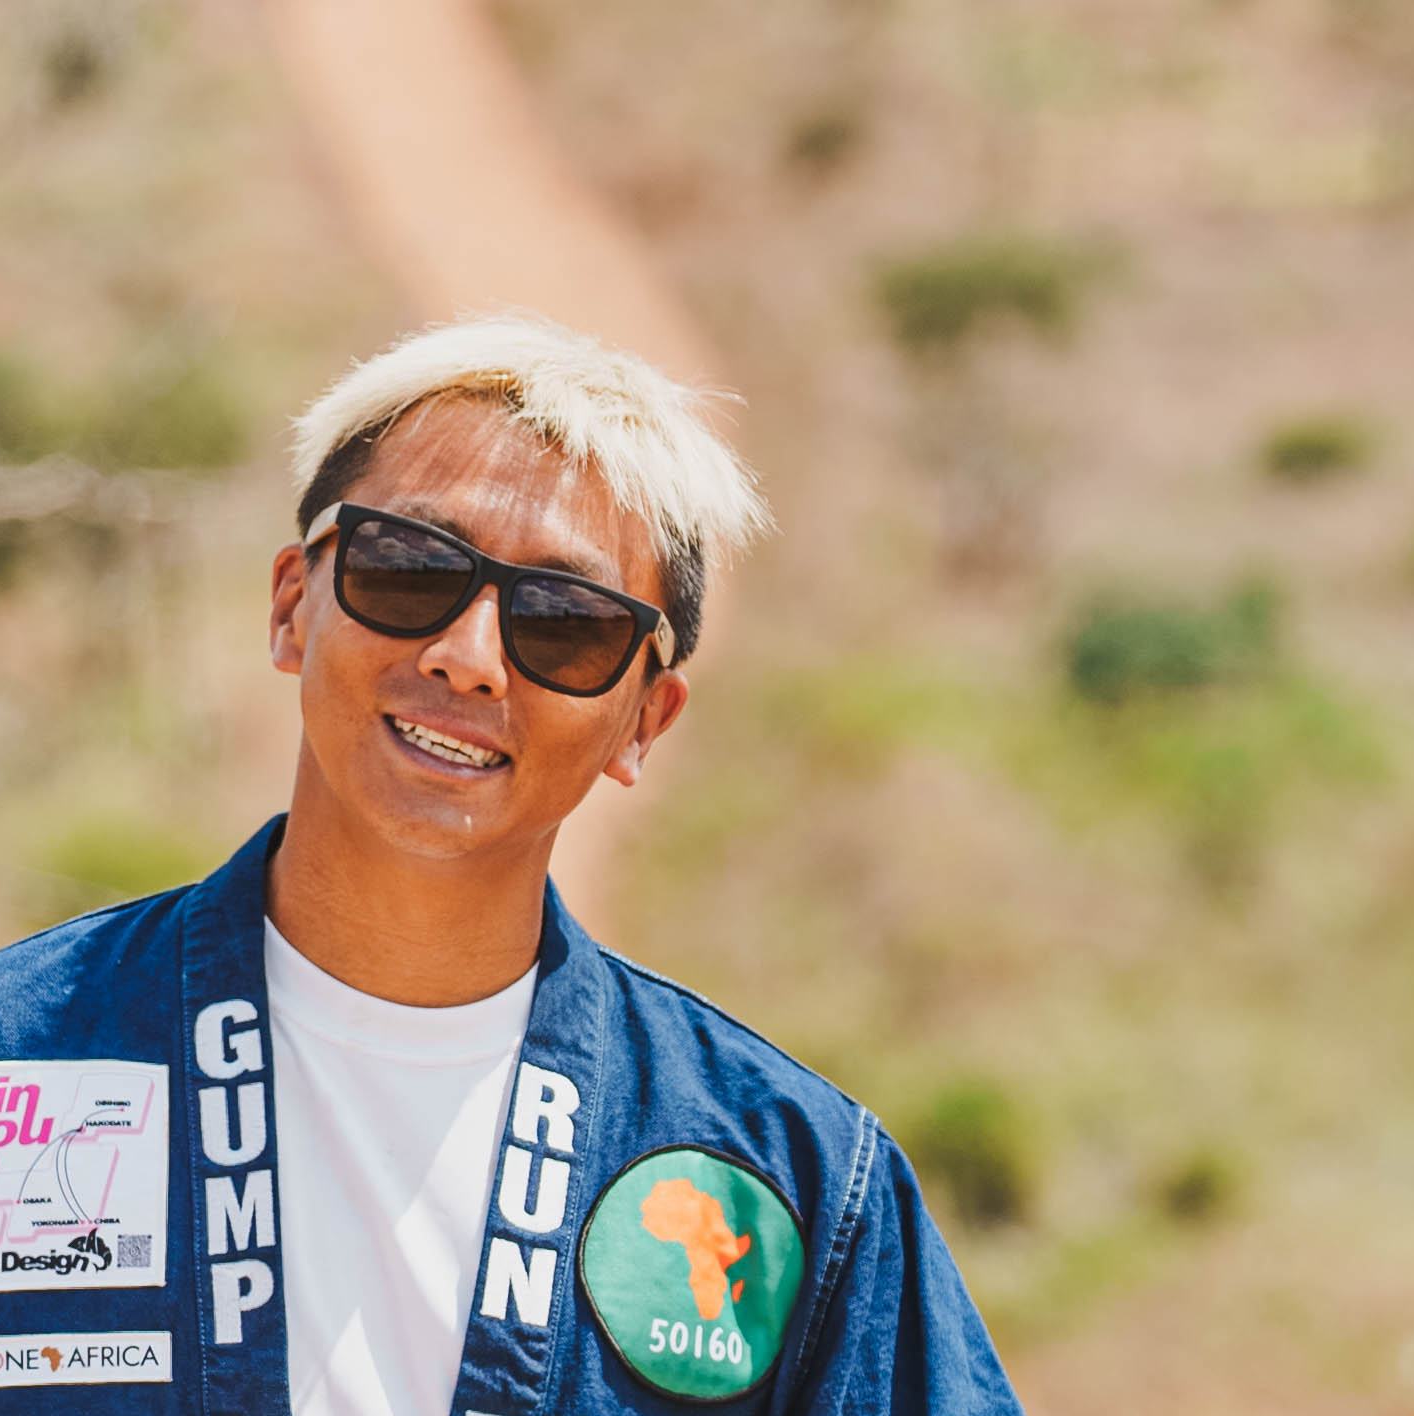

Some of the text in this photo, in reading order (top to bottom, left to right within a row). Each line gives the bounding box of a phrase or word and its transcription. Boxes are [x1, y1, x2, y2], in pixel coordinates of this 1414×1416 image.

[194, 999, 277, 1344] GUMP
[479, 1061, 580, 1327] RUN
[2, 1249, 89, 1275] Design
[67, 1345, 158, 1368] AFRICA
[649, 1318, 743, 1364] 50160
